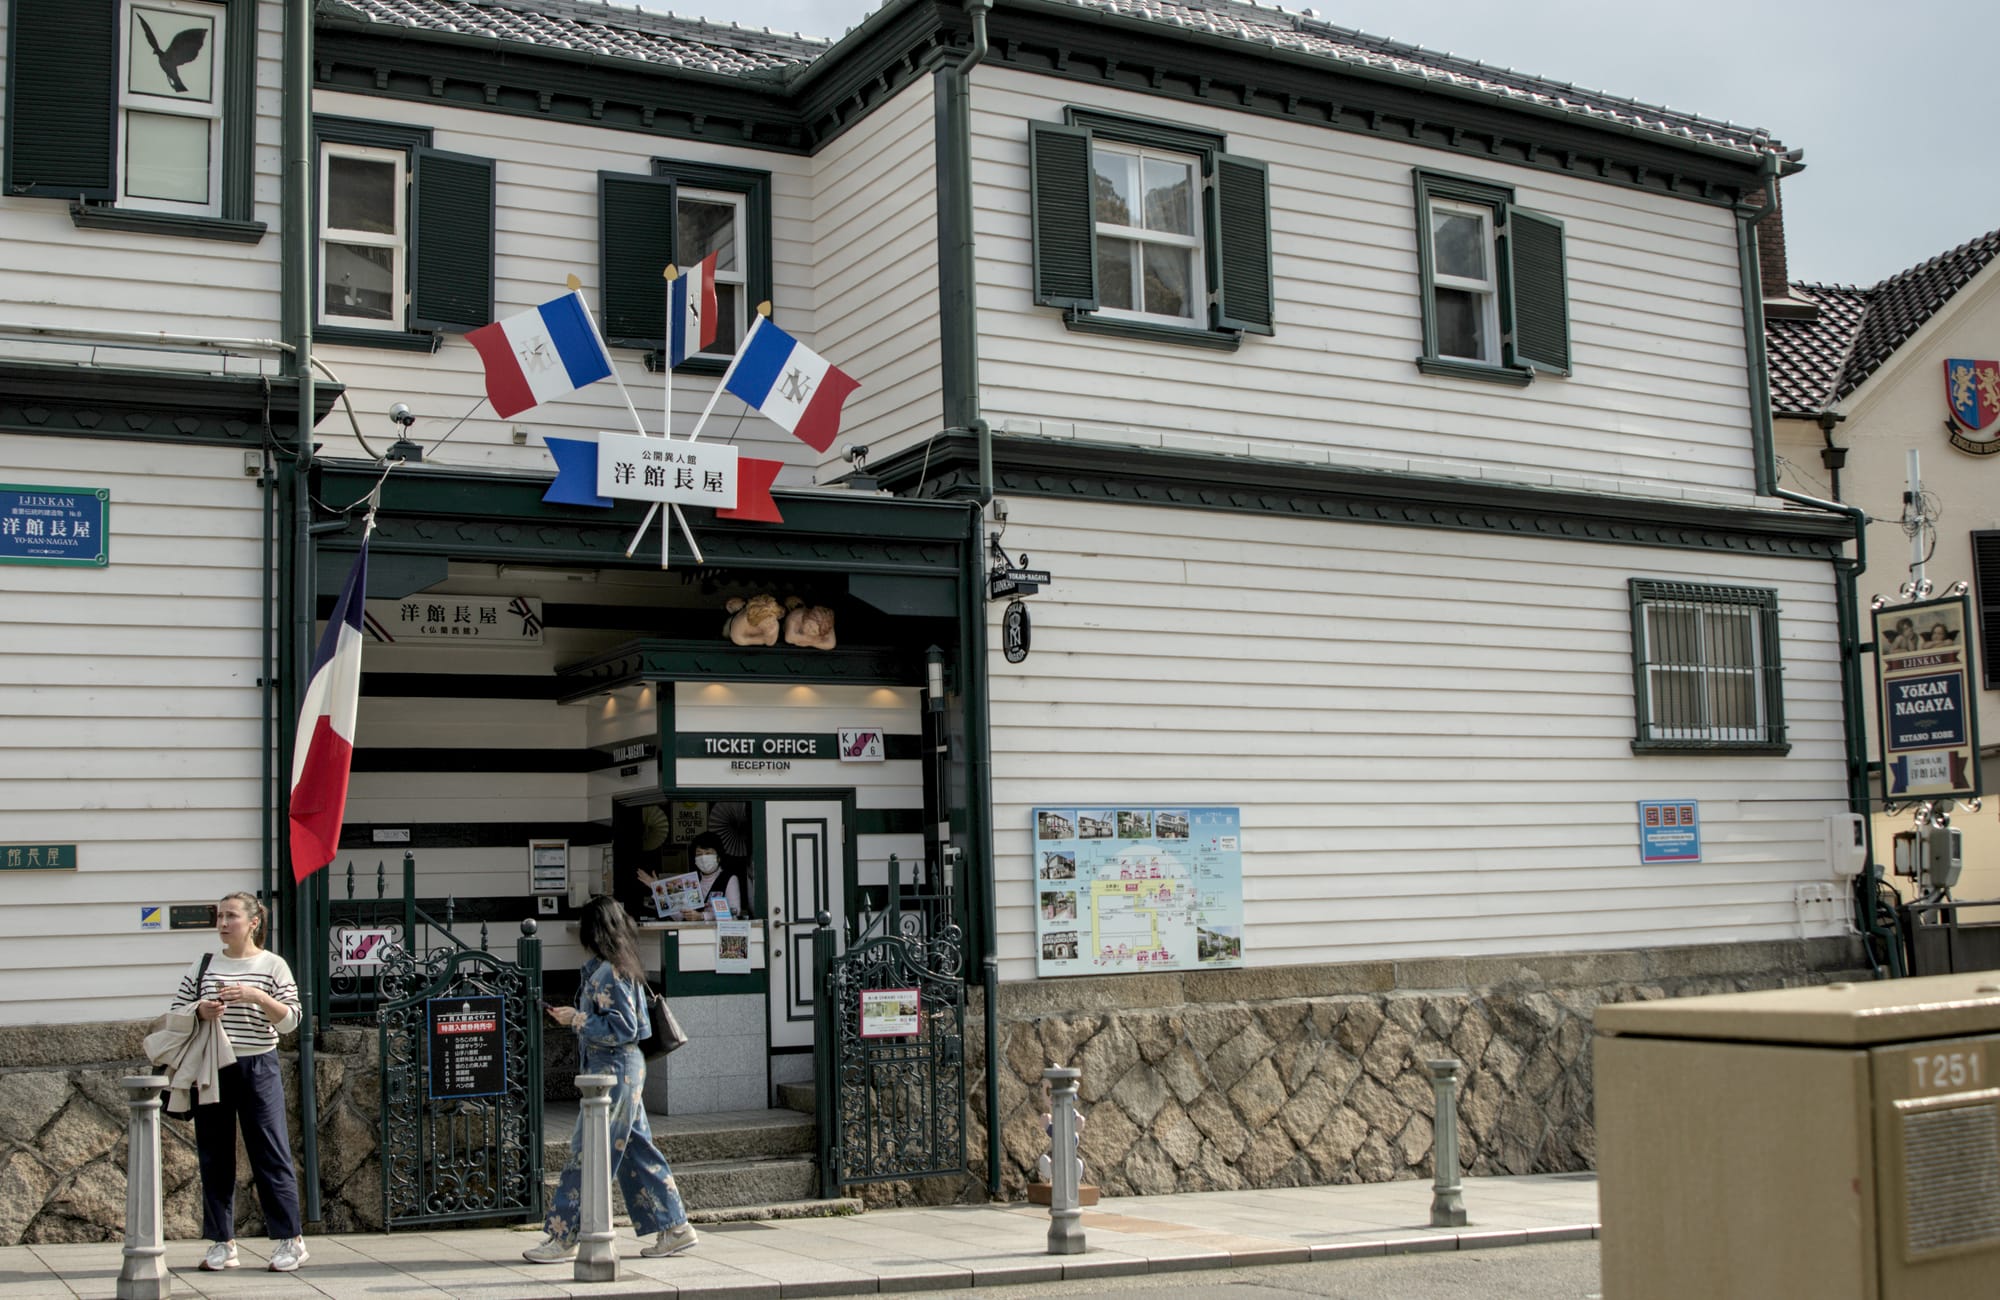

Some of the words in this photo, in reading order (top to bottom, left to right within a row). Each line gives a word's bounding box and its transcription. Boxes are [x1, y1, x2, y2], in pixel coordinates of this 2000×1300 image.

[642, 450, 697, 465] 公開異人館
[614, 461, 724, 493] 洋館長屋
[19, 495, 75, 507] IJINKAN
[3, 517, 90, 538] 洋館長屋
[14, 536, 79, 546] YO-KAN-NAGAYA
[401, 603, 498, 625] 洋館長屋
[1903, 655, 1942, 668] IJINKAN
[1896, 697, 1955, 716] NAGAYA
[1899, 732, 1930, 742] KITANO
[1931, 730, 1954, 739] KOBE
[704, 738, 756, 753] TICKET
[762, 738, 817, 754] OFFICE
[730, 761, 791, 770] RECEPTION
[0, 848, 60, 867] 館長屋
[346, 949, 367, 960] NO
[1912, 1053, 1980, 1087] T251
